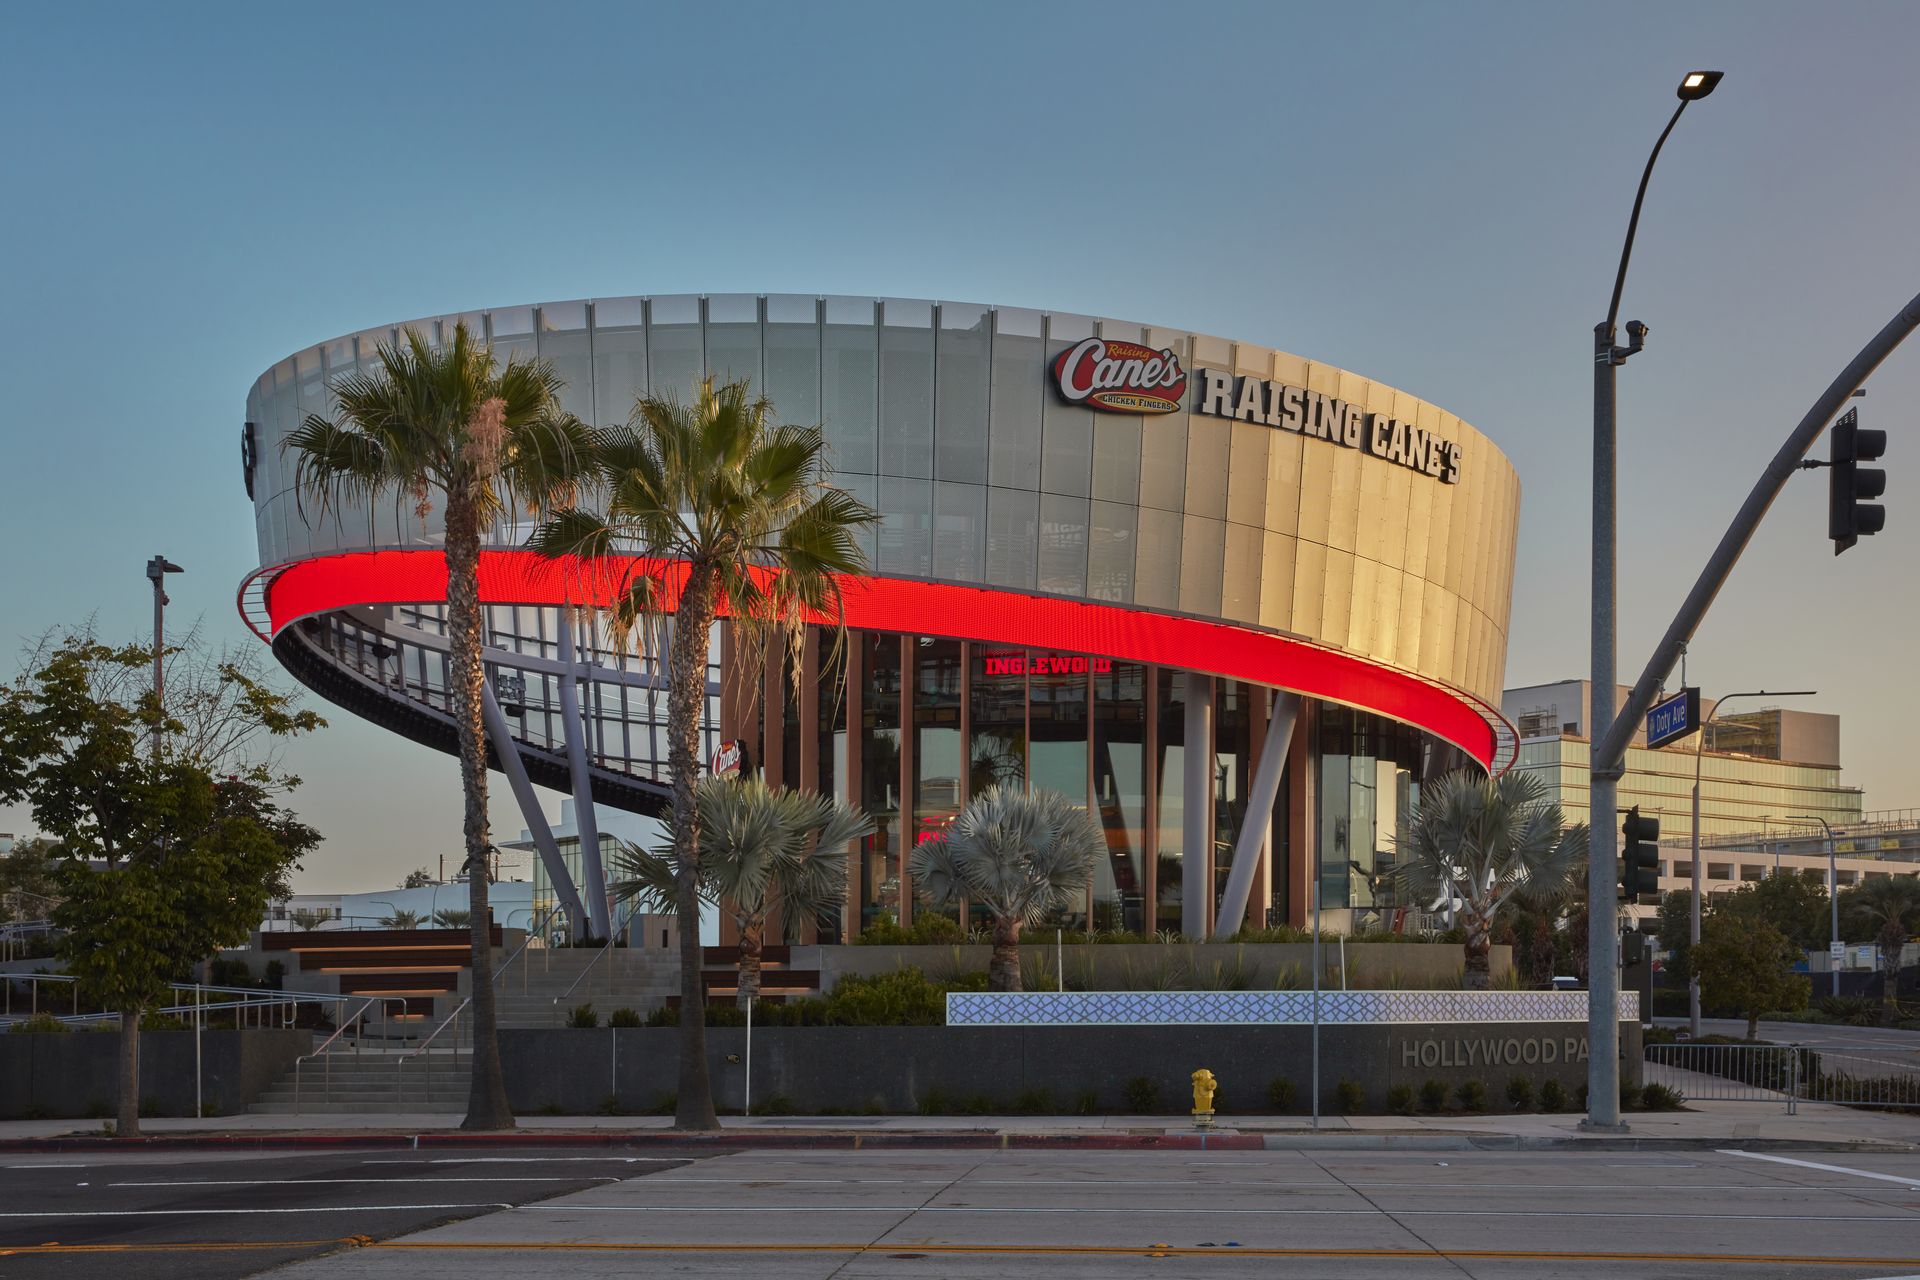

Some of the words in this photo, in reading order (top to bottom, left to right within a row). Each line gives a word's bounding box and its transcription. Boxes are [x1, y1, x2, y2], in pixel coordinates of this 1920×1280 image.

[1106, 343, 1151, 361] Raising
[1061, 338, 1185, 400] Cane's
[1102, 394, 1136, 406] CHICKEN
[1138, 398, 1172, 411] FINGERS
[1202, 368, 1365, 449] RAISING
[1371, 413, 1463, 484] CANE'S
[1673, 704, 1685, 725] Ave
[1402, 1038, 1558, 1068] HOLLYWOOD
[1564, 1037, 1590, 1064] PA
